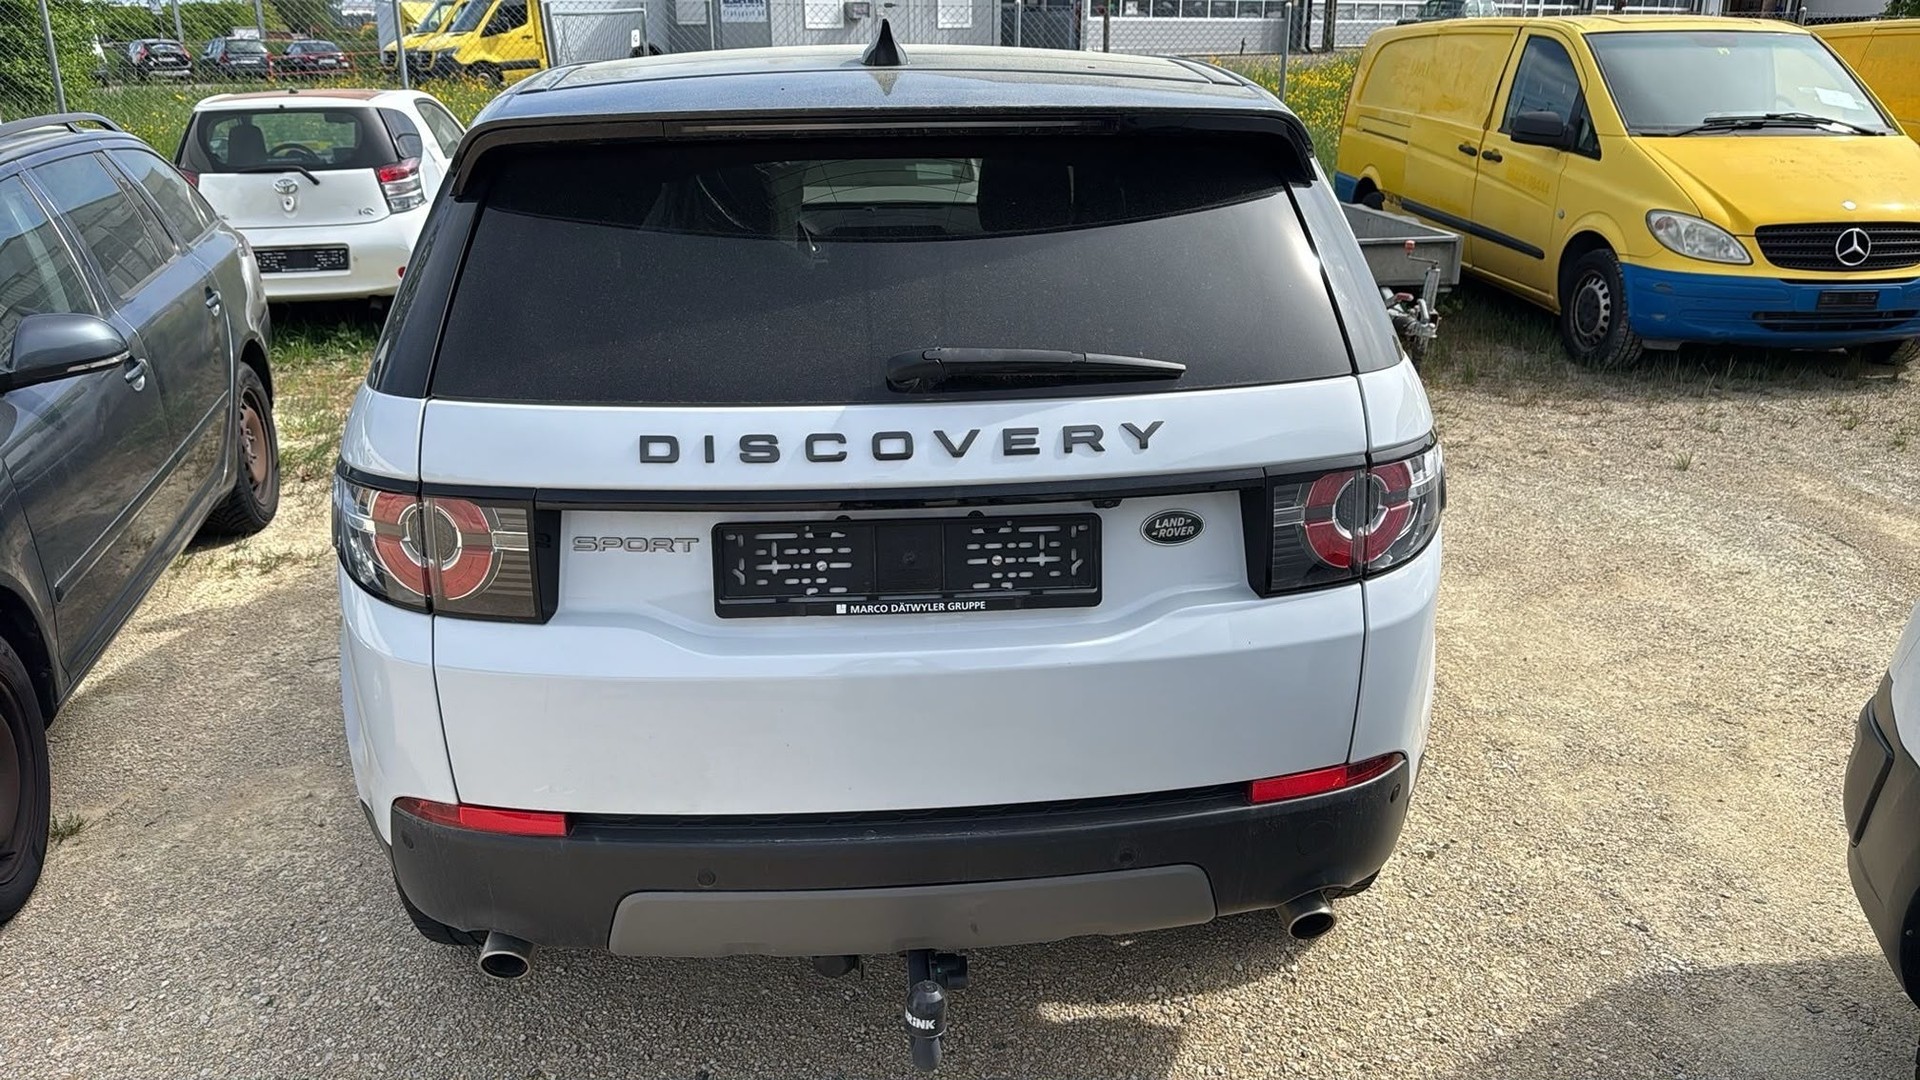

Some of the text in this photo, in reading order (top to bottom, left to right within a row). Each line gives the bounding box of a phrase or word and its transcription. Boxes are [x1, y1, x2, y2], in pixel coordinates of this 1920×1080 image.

[639, 420, 1165, 464] DISCOVERY
[572, 536, 700, 553] SPORT
[850, 601, 986, 614] MARCO DÄTWYLER GRUPPE
